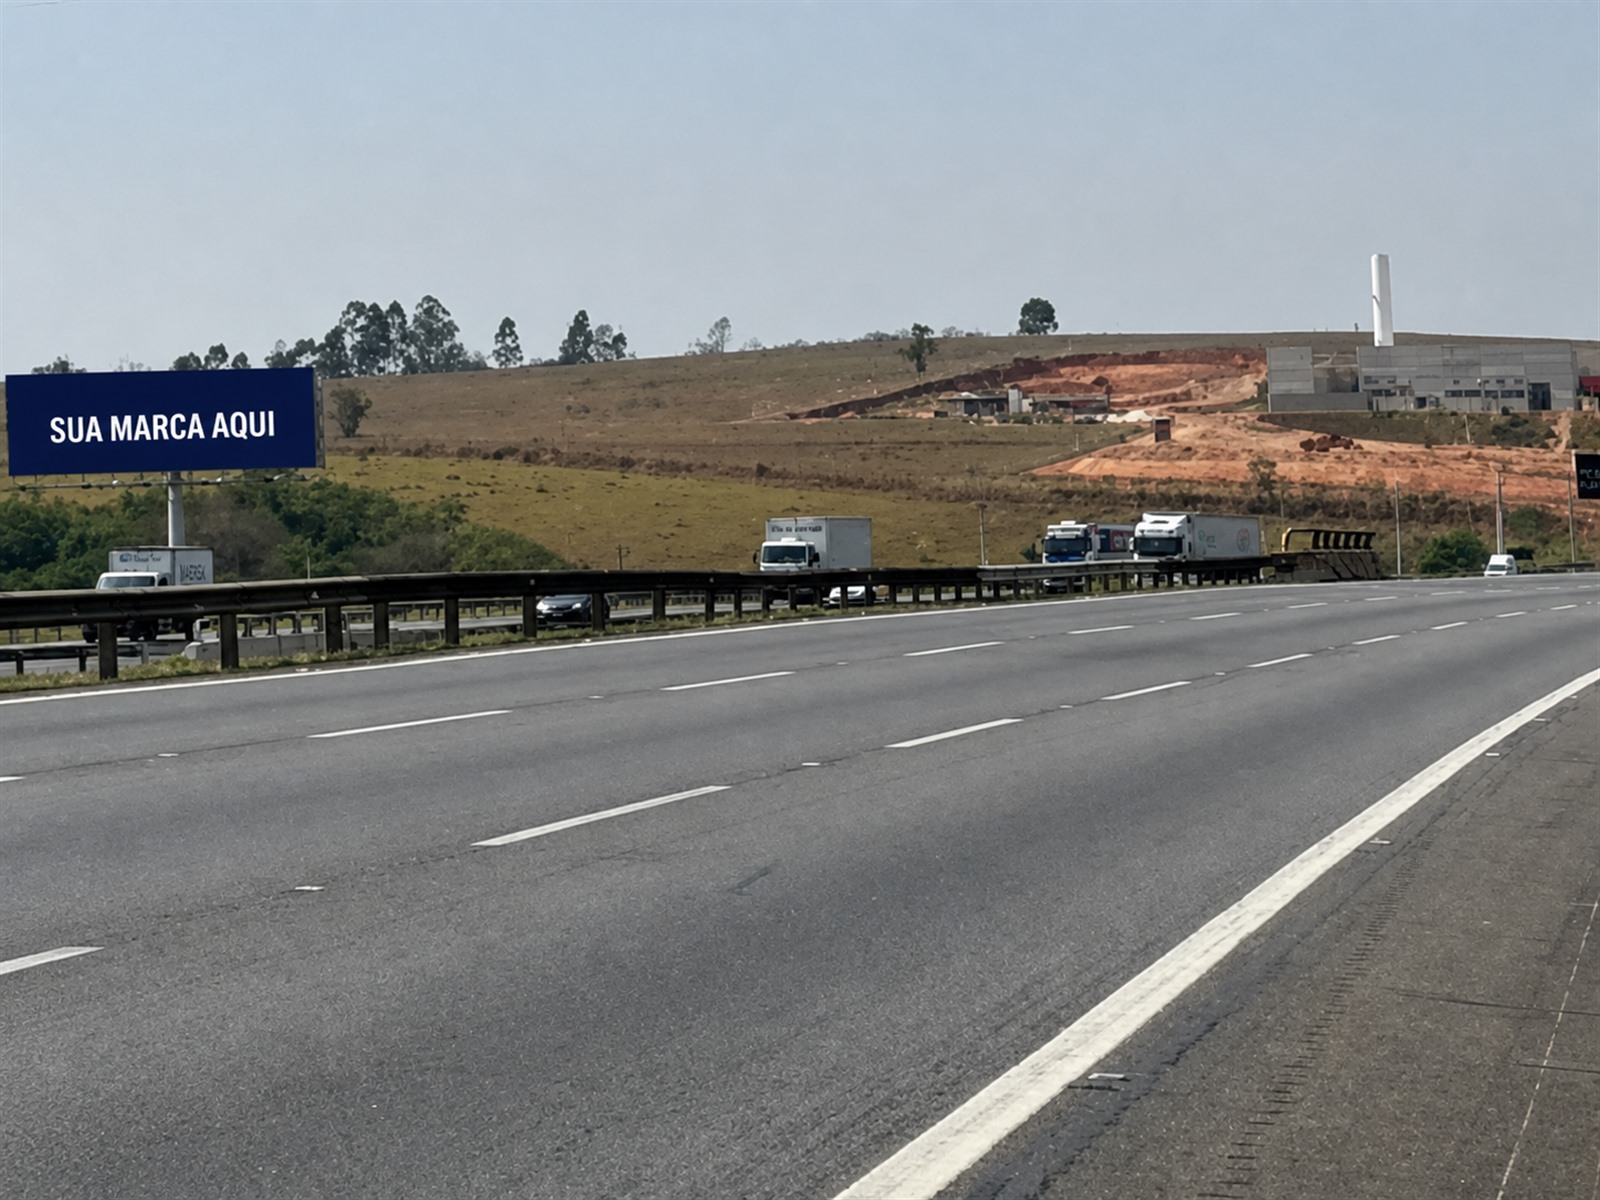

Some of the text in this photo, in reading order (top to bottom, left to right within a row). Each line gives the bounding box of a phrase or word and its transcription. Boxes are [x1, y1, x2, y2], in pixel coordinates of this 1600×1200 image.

[50, 410, 275, 444] SUA MARCA AQUI
